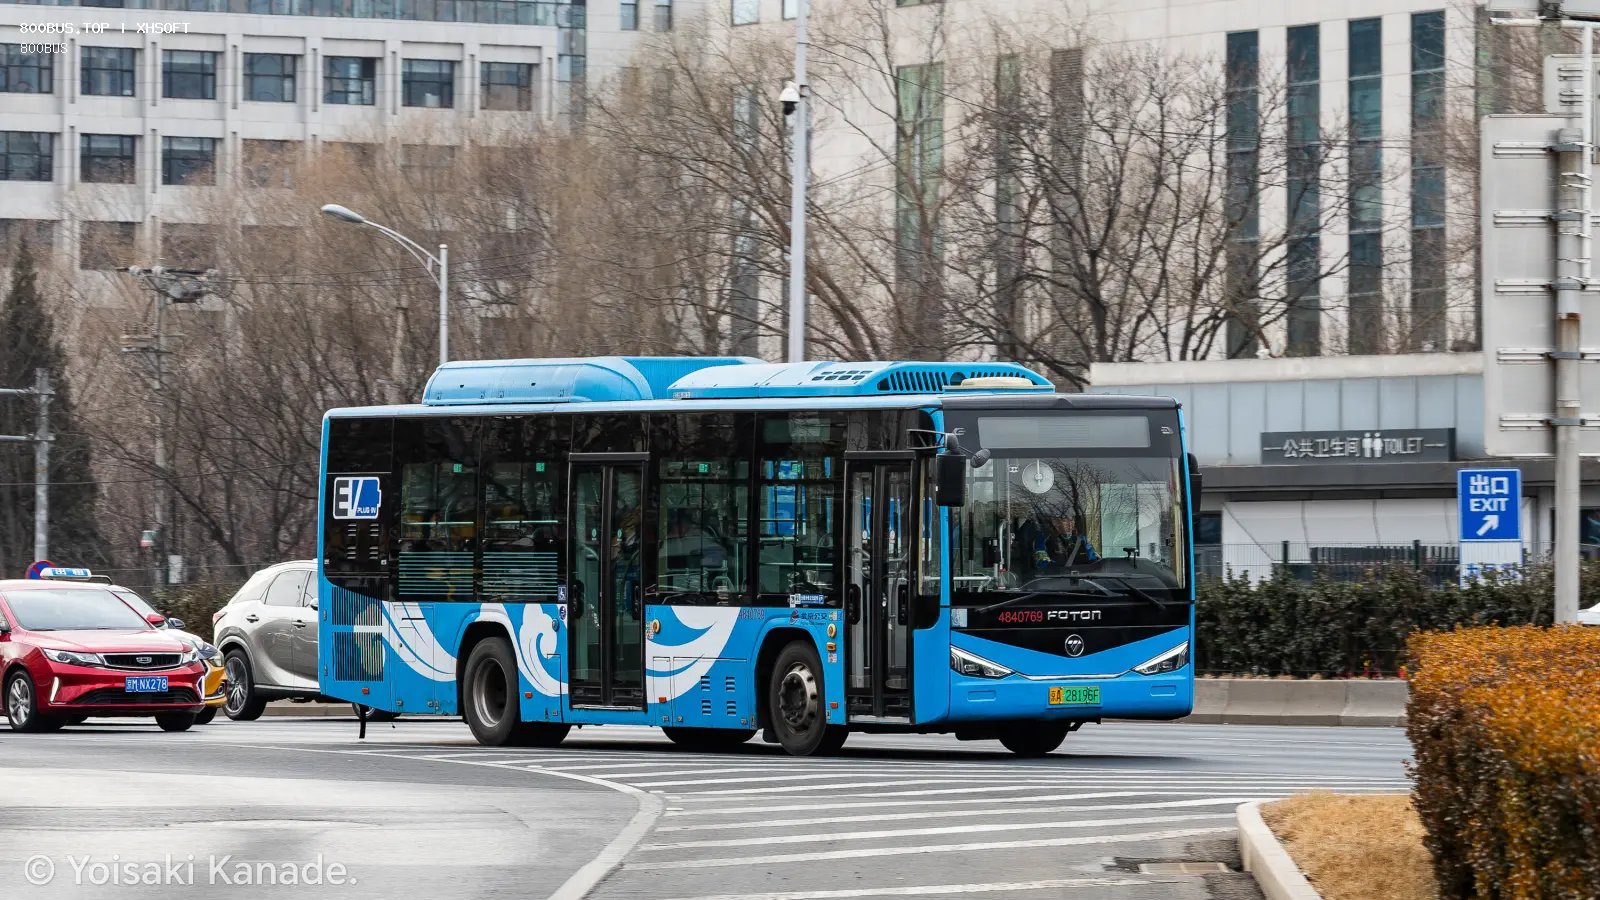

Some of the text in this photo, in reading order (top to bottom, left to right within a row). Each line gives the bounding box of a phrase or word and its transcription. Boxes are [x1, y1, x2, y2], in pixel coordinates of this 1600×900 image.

[1284, 437, 1424, 458] 公共卫生间 TOILET
[1470, 475, 1509, 495] 出口
[1470, 498, 1509, 512] EXIT
[998, 611, 1043, 622] 4840769
[1048, 610, 1102, 620] FOTON
[1065, 690, 1099, 702] 28196F
